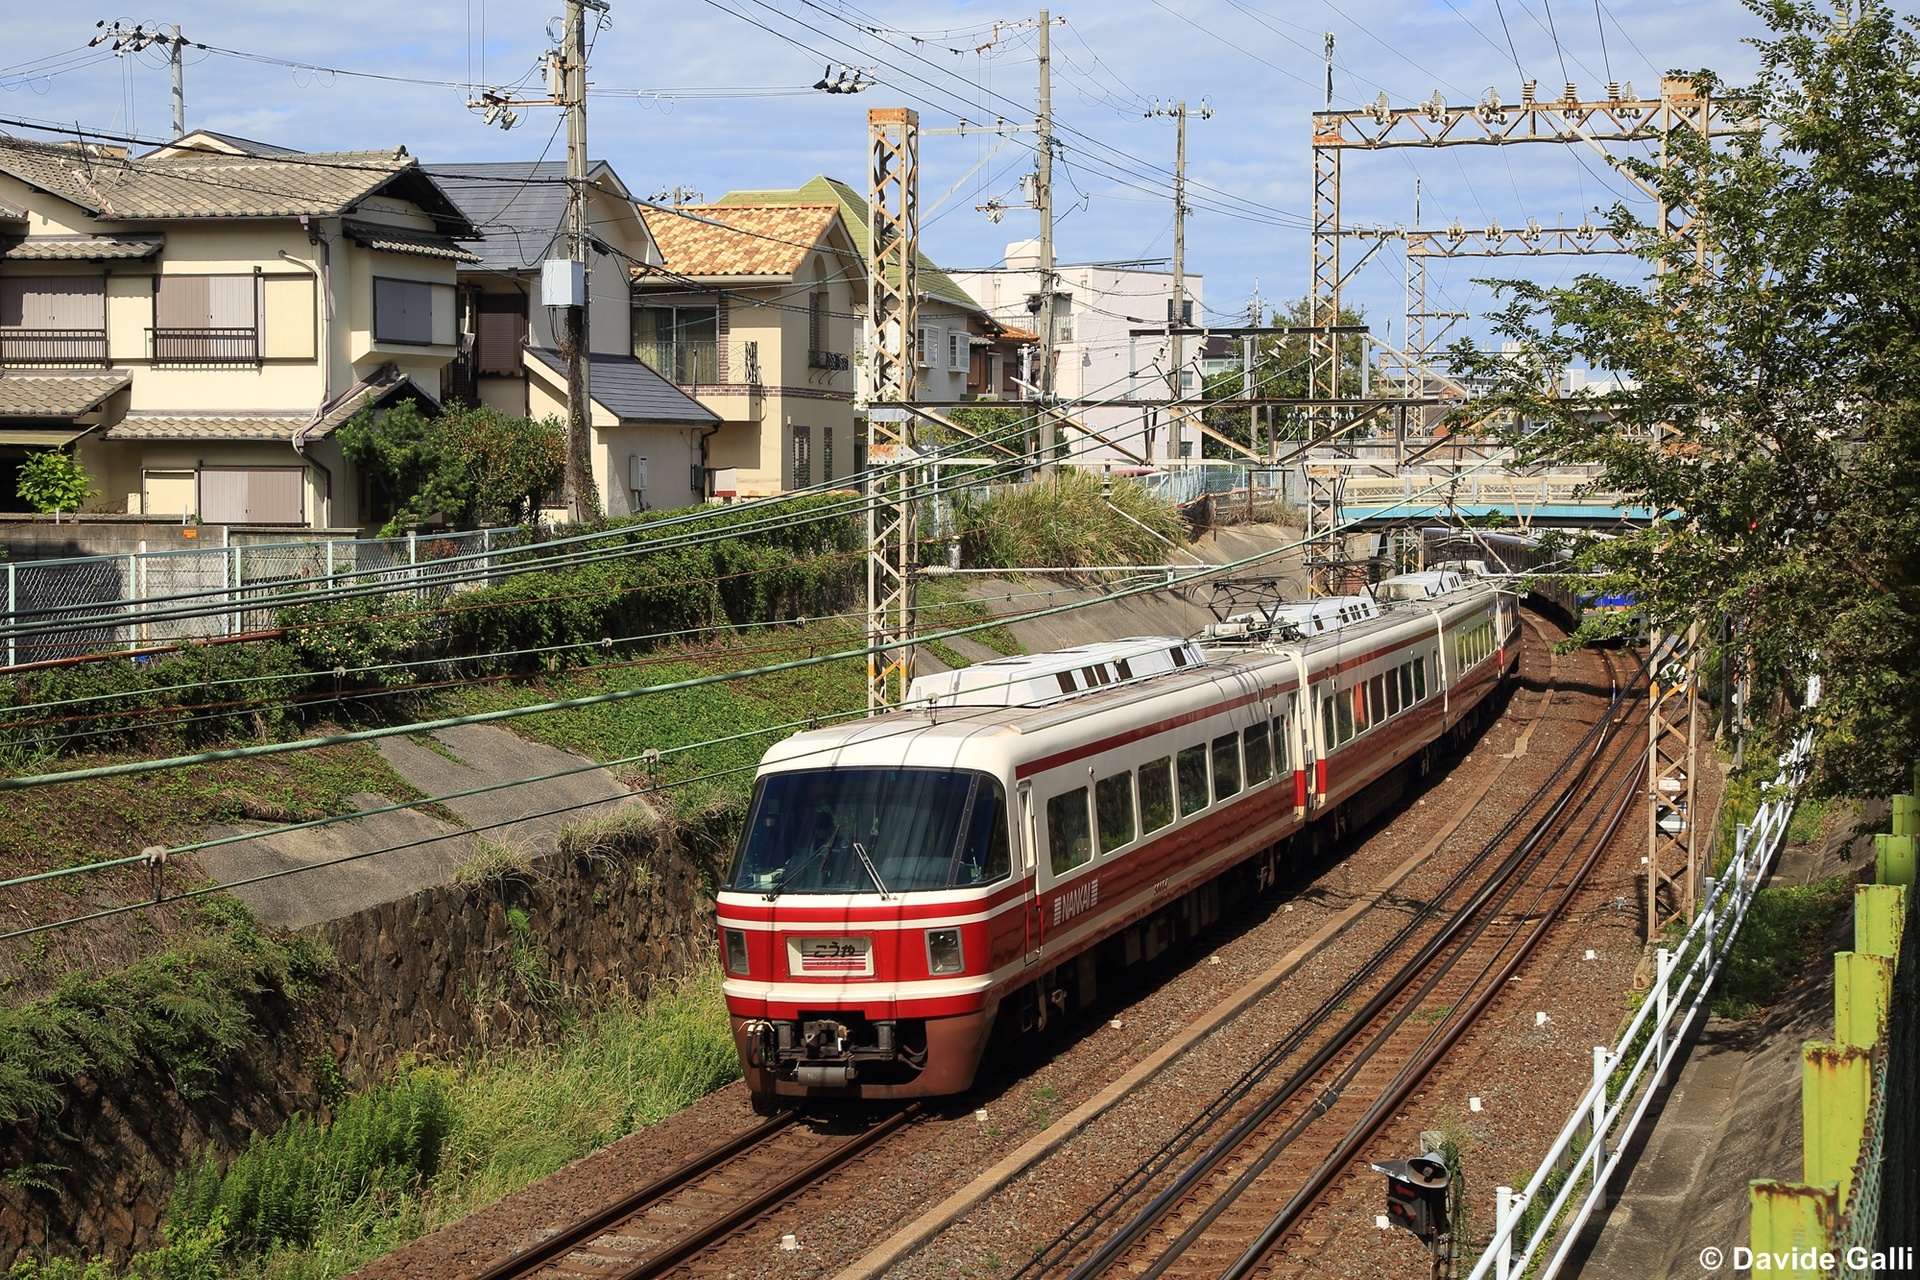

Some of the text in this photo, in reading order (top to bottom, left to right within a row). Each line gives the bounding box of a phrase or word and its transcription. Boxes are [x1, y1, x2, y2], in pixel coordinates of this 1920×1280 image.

[1062, 883, 1091, 921] NANKAI
[814, 941, 855, 958] こうや
